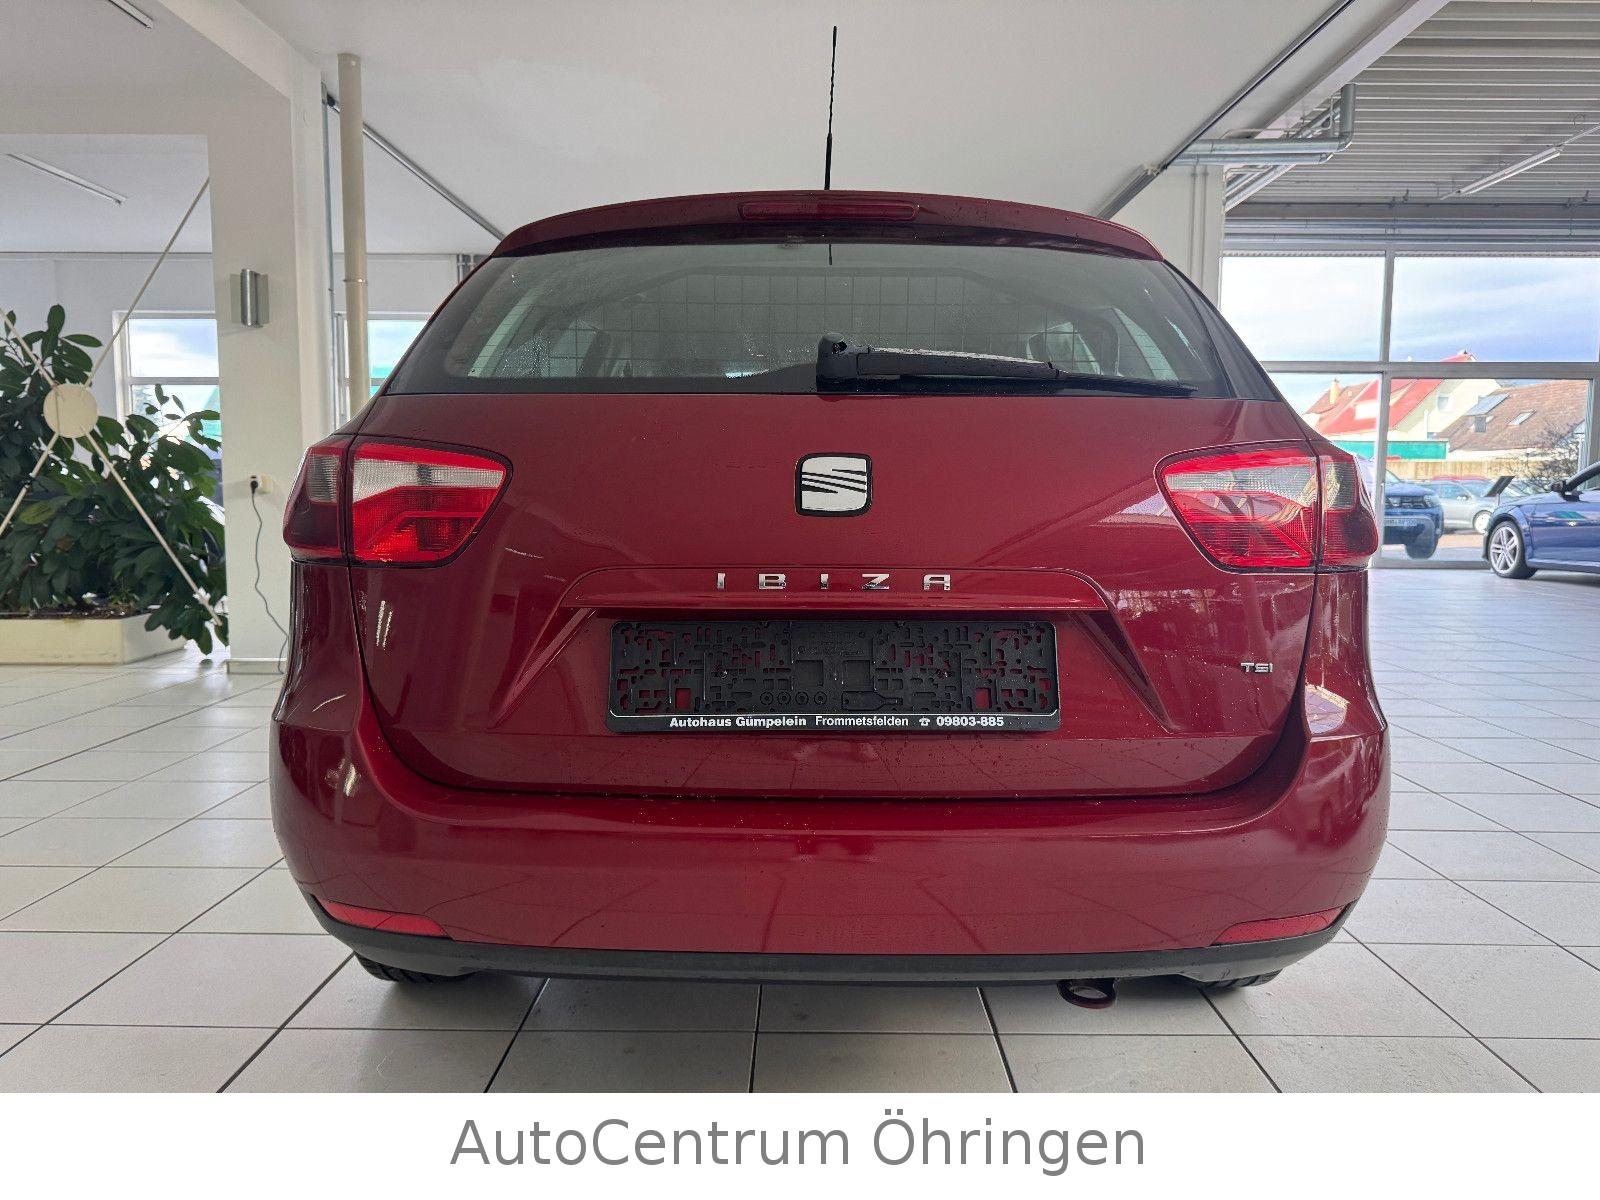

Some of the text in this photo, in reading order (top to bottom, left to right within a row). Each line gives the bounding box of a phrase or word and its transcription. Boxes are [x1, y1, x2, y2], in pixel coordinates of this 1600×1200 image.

[716, 572, 951, 591] IBIZA
[1240, 662, 1274, 673] TSI
[669, 715, 1005, 729] Autohaus Gümpelein Frommetsfelden 09803-885
